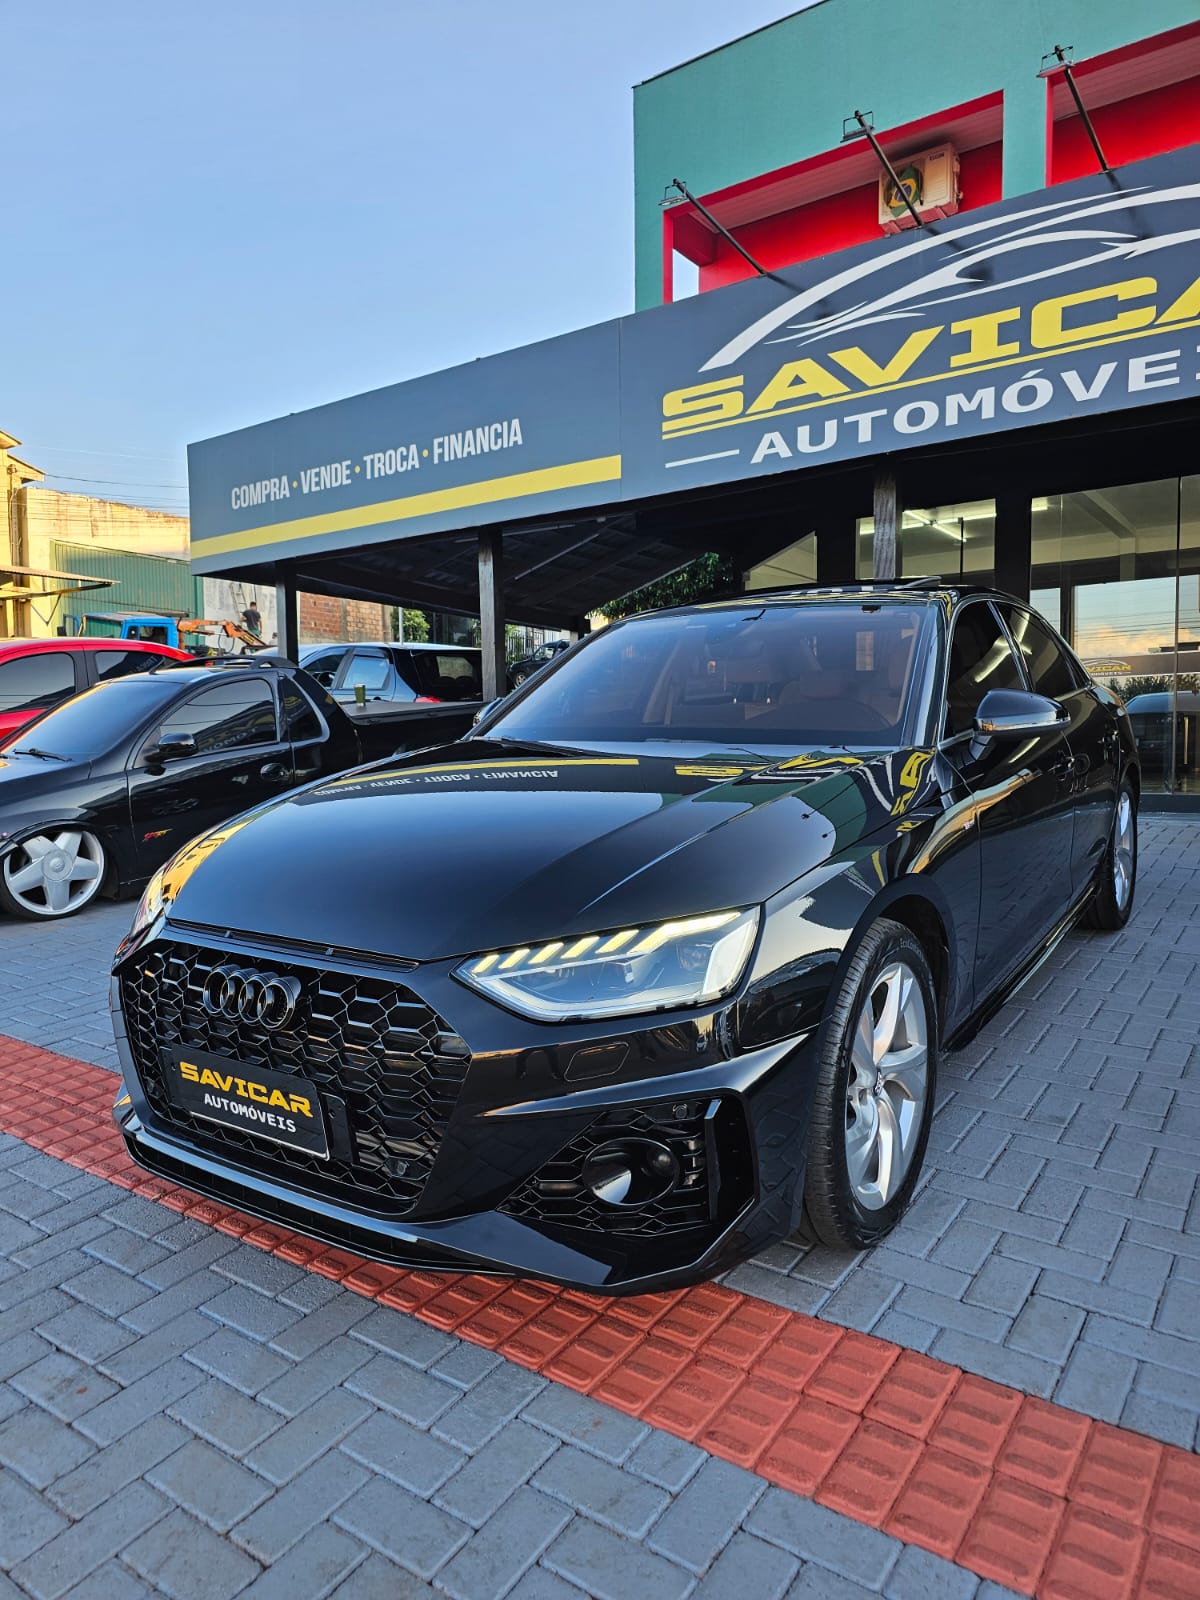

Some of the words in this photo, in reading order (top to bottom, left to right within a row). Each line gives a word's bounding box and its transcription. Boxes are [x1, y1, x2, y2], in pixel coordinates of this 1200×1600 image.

[751, 345, 1200, 464] AUTOMÓVE
[231, 475, 291, 510] COMPRA
[300, 460, 352, 495] VENDE
[363, 444, 420, 480] TROCA
[433, 418, 523, 465] FINANCIA
[179, 1061, 314, 1118] SAVICAR
[204, 1093, 297, 1133] AUTOMÓVEIS
